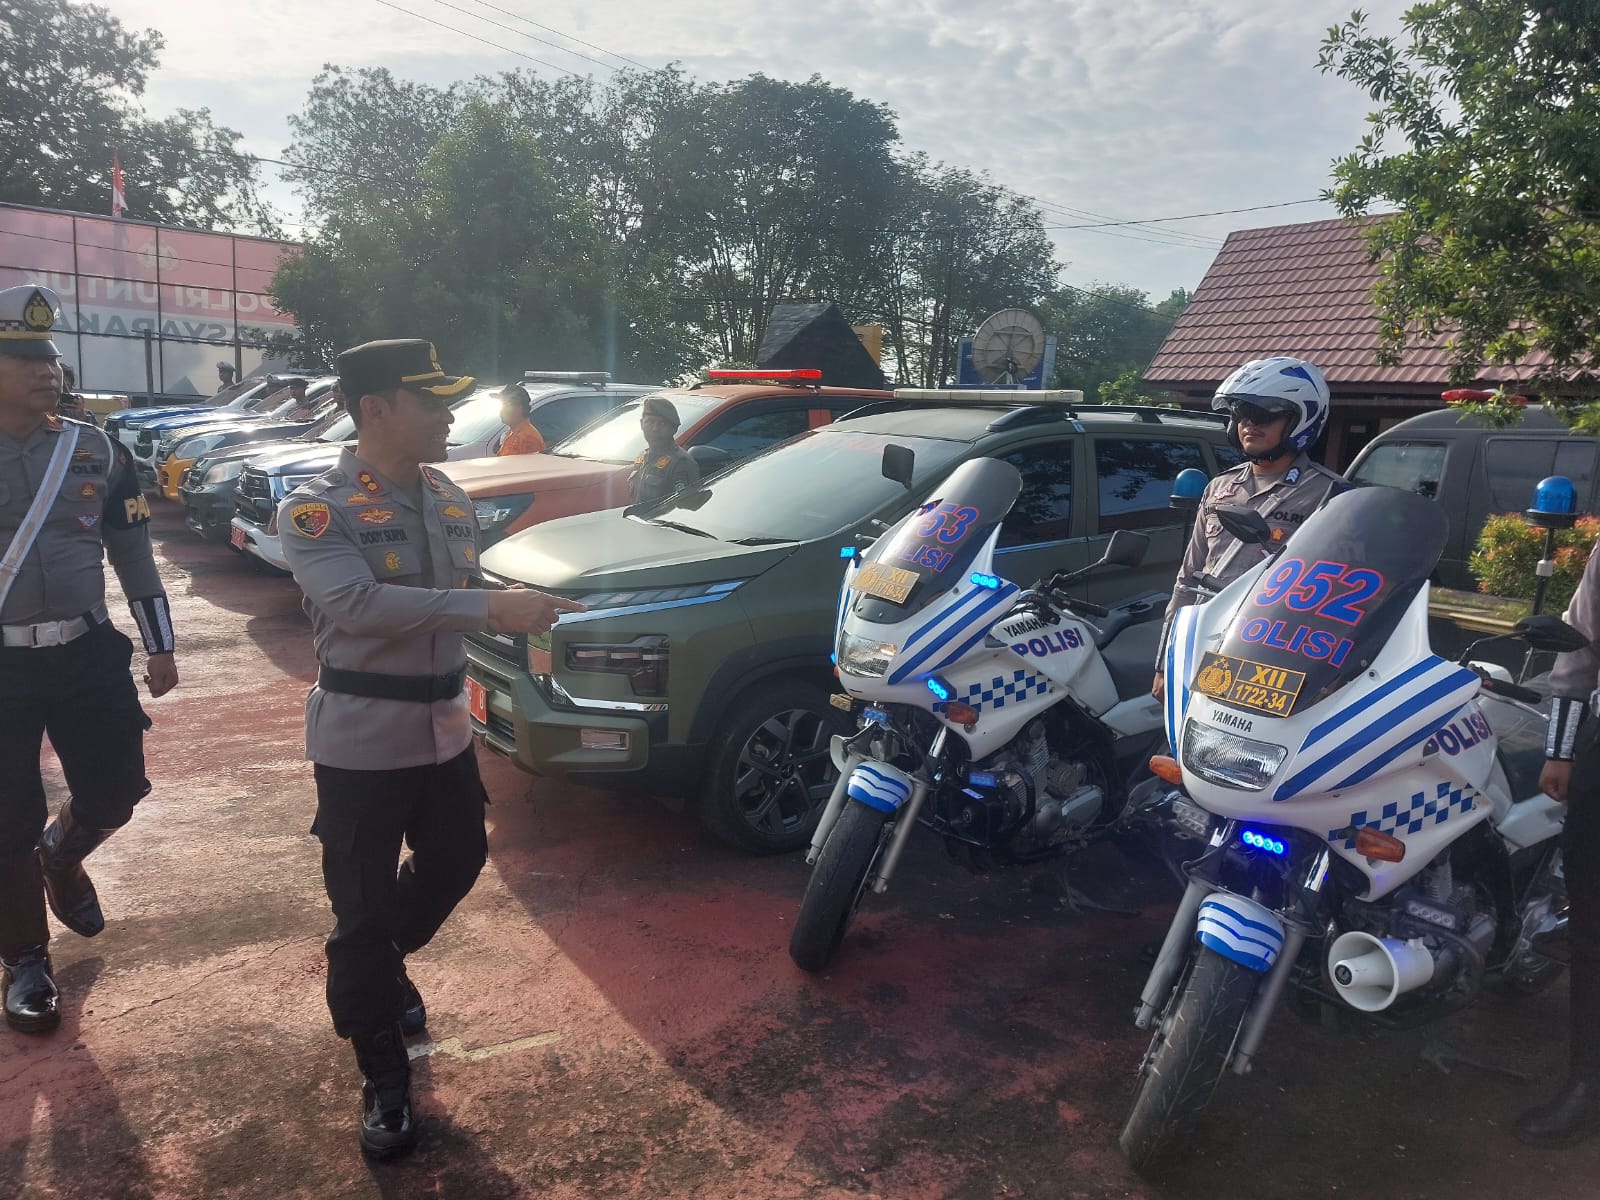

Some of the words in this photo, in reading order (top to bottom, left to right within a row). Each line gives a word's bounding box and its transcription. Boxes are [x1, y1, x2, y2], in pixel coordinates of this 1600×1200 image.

[1254, 558, 1384, 626] 952
[1003, 618, 1049, 638] YAMAHA
[1010, 627, 1085, 657] POLISI
[1250, 665, 1288, 688] XII
[1235, 684, 1287, 711] 1722-34
[1212, 709, 1253, 733] YAMAHA
[1423, 711, 1493, 757] POLISI
